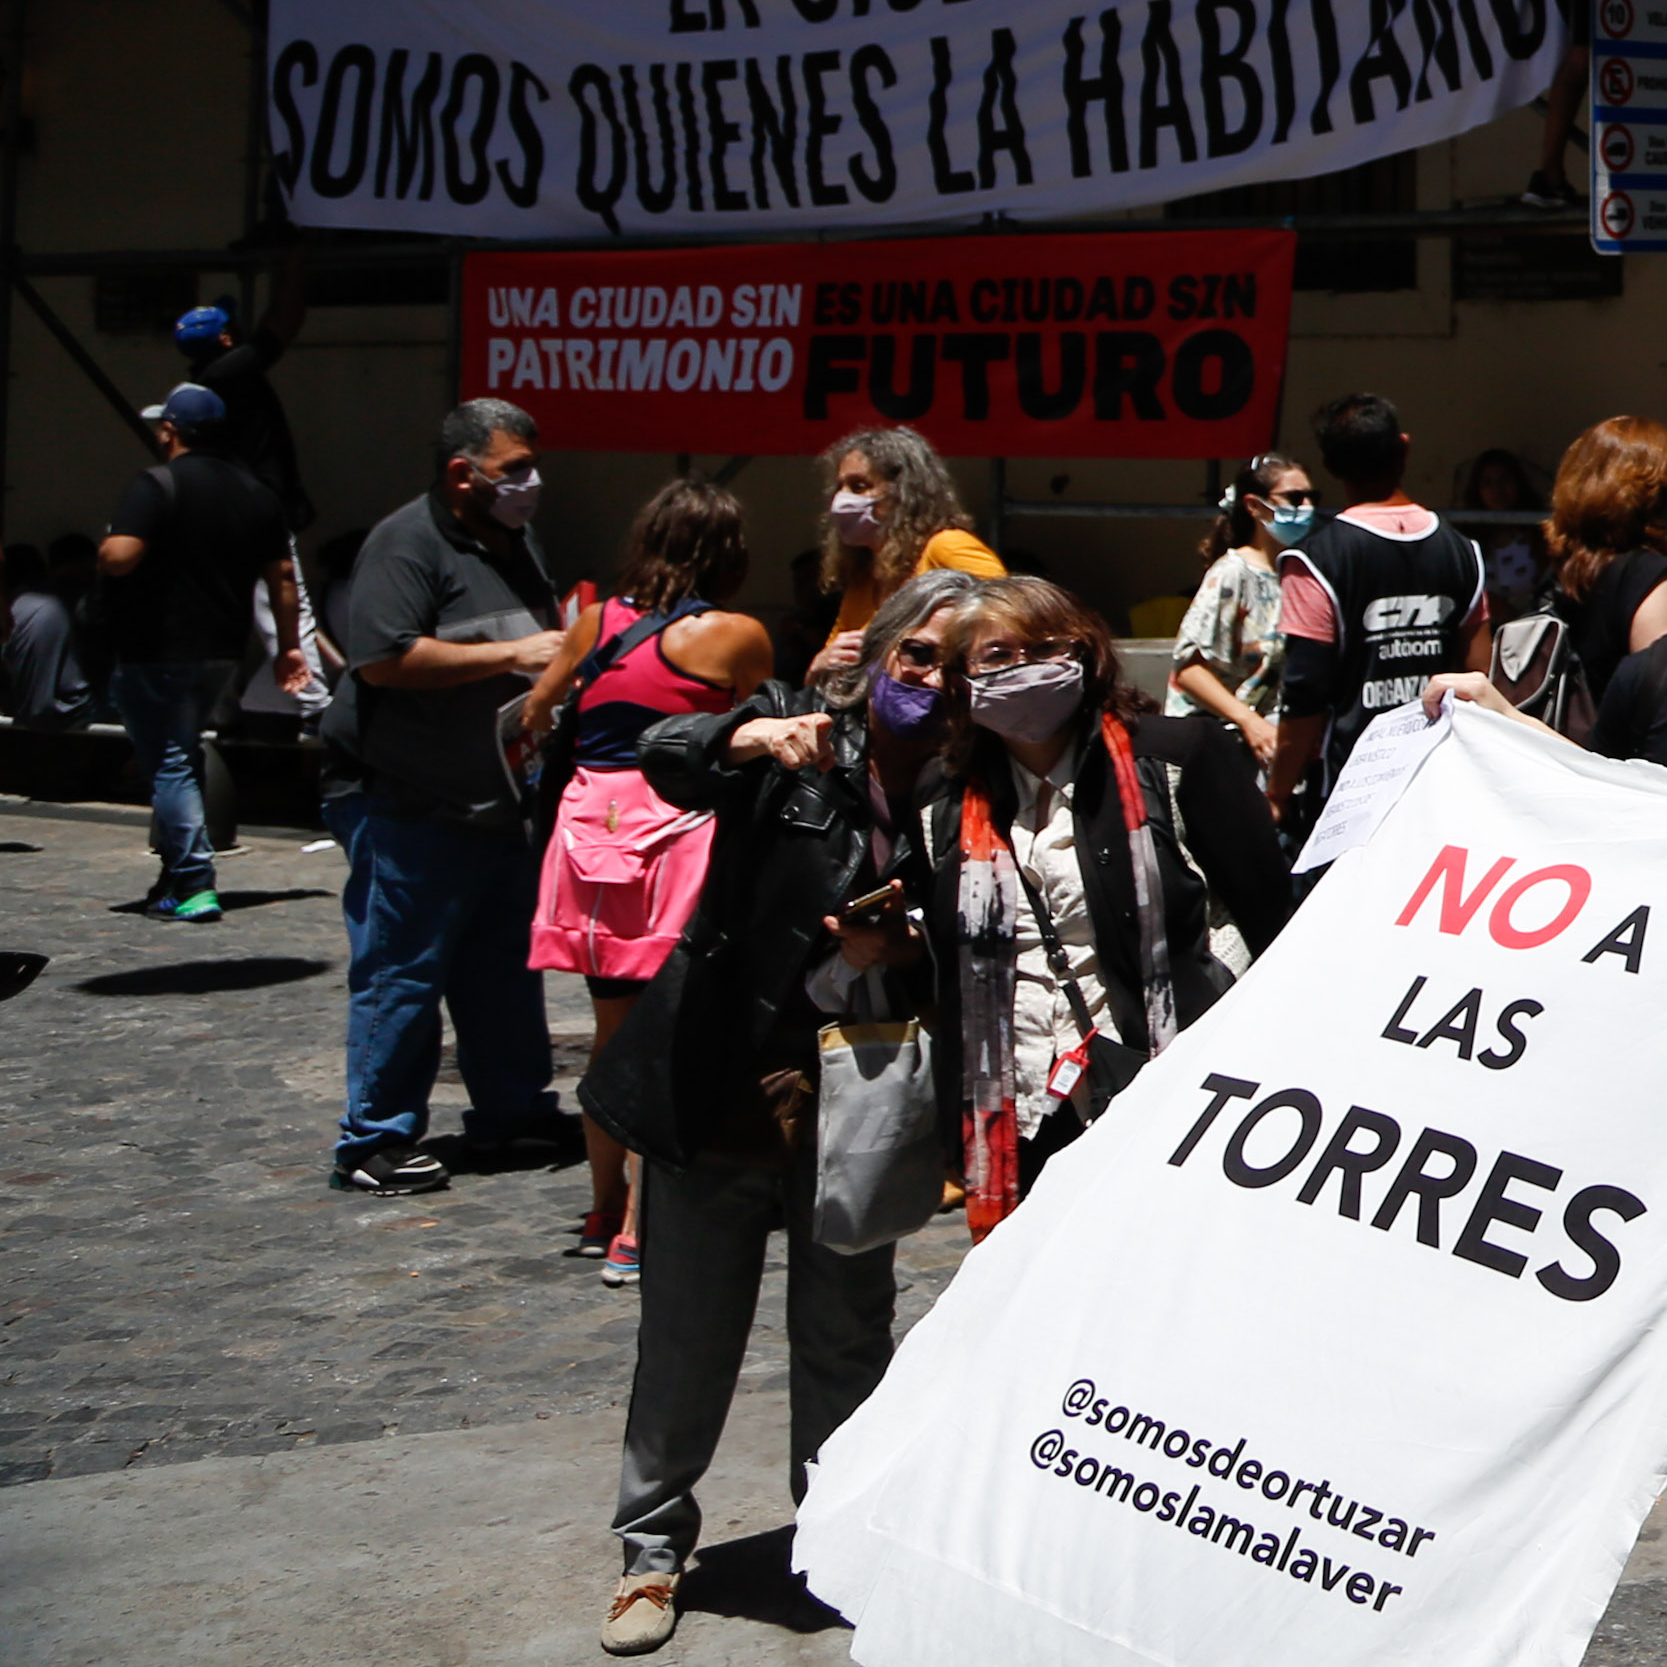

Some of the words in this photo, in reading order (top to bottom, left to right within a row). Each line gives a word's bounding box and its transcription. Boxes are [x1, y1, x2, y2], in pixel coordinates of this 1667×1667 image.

[1608, 3, 1626, 24] 10
[273, 40, 548, 208] SOMOS
[569, 44, 897, 234] QUIENES
[928, 29, 1033, 194] LA
[487, 287, 559, 328] UNA
[568, 284, 724, 329] CIUDAD
[731, 282, 802, 327] SIN
[814, 282, 861, 326] ES
[873, 278, 957, 325] UNA
[970, 274, 1155, 324] CIUDAD
[1167, 273, 1256, 319] SIN
[487, 337, 794, 393] PATRIMONIO
[804, 329, 1255, 421] FUTURO
[1395, 844, 1593, 950] NO
[1581, 905, 1651, 974] A
[1380, 975, 1544, 1069] LAS
[1167, 1073, 1647, 1301] TORRES
[1062, 1378, 1435, 1558] @somosdeortuzar
[1029, 1429, 1402, 1612] @somoslamalaver
